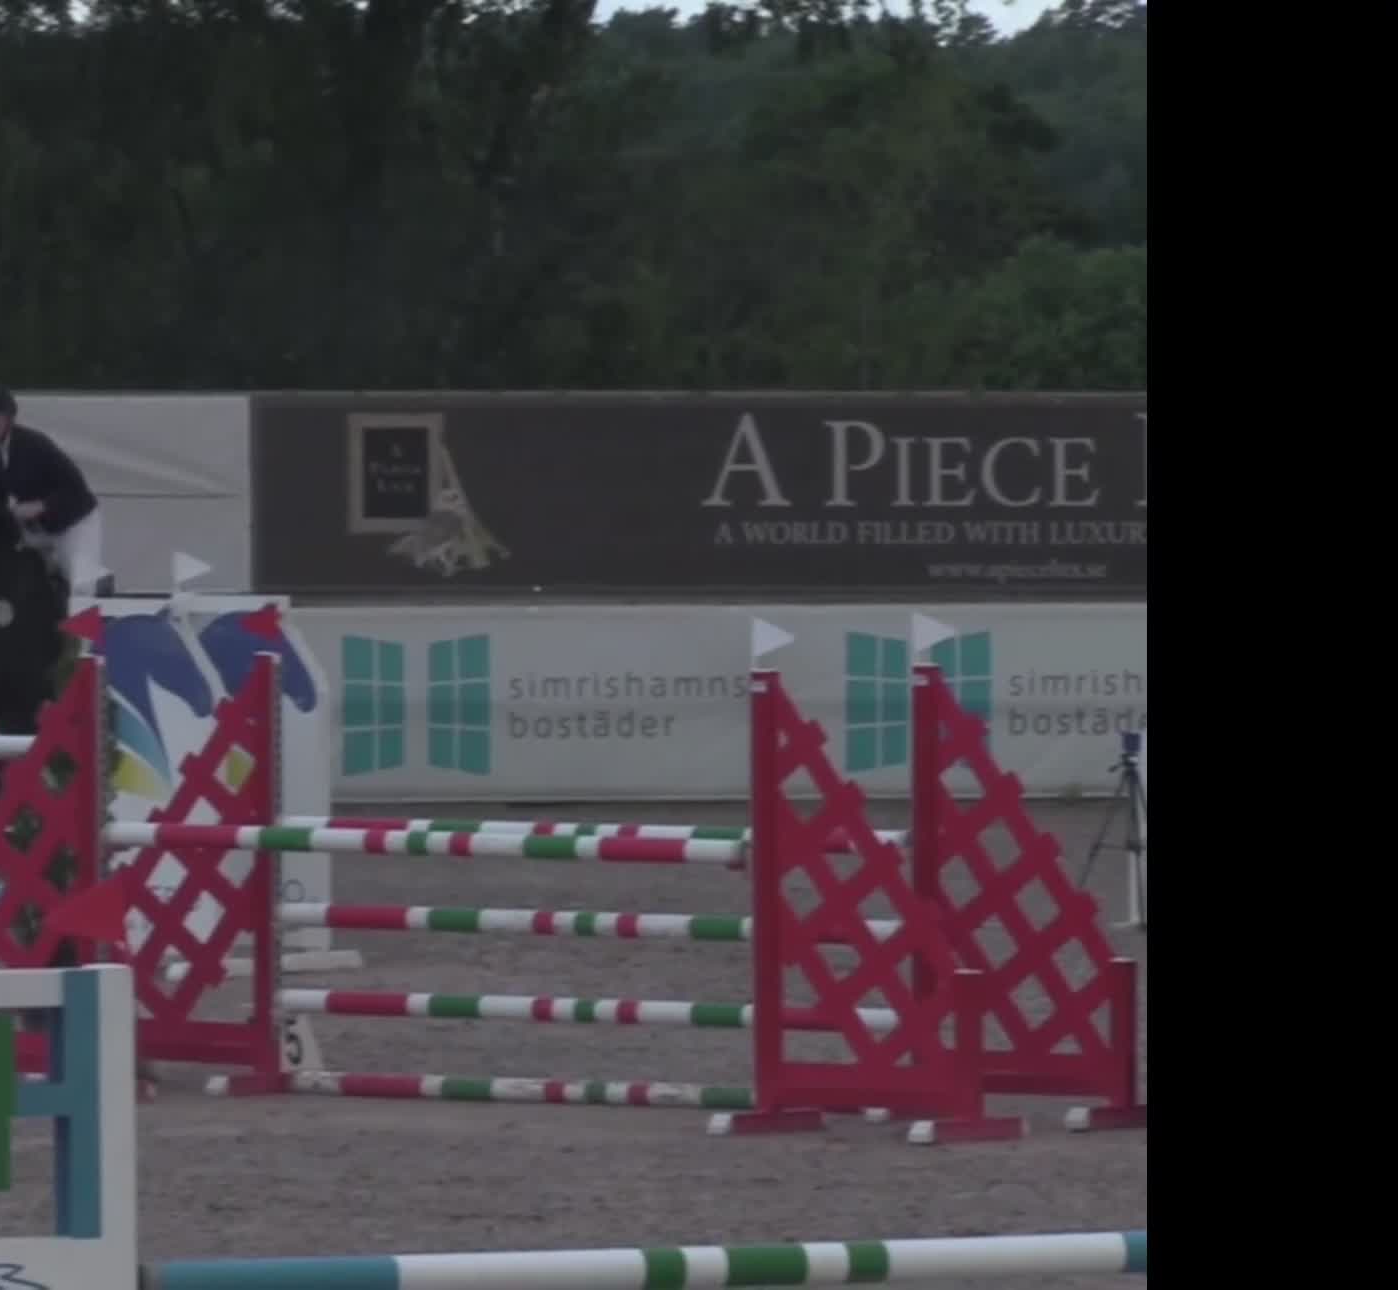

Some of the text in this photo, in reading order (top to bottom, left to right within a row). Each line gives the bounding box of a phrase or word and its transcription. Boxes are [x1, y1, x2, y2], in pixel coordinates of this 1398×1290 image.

[703, 413, 792, 507] A
[714, 521, 733, 545] A
[743, 521, 849, 545] WORLD
[858, 521, 954, 545] FILLED
[964, 521, 1040, 545] WITH
[508, 671, 747, 699] simrishamns
[508, 711, 675, 738] bostäder
[284, 1018, 305, 1065] 5
